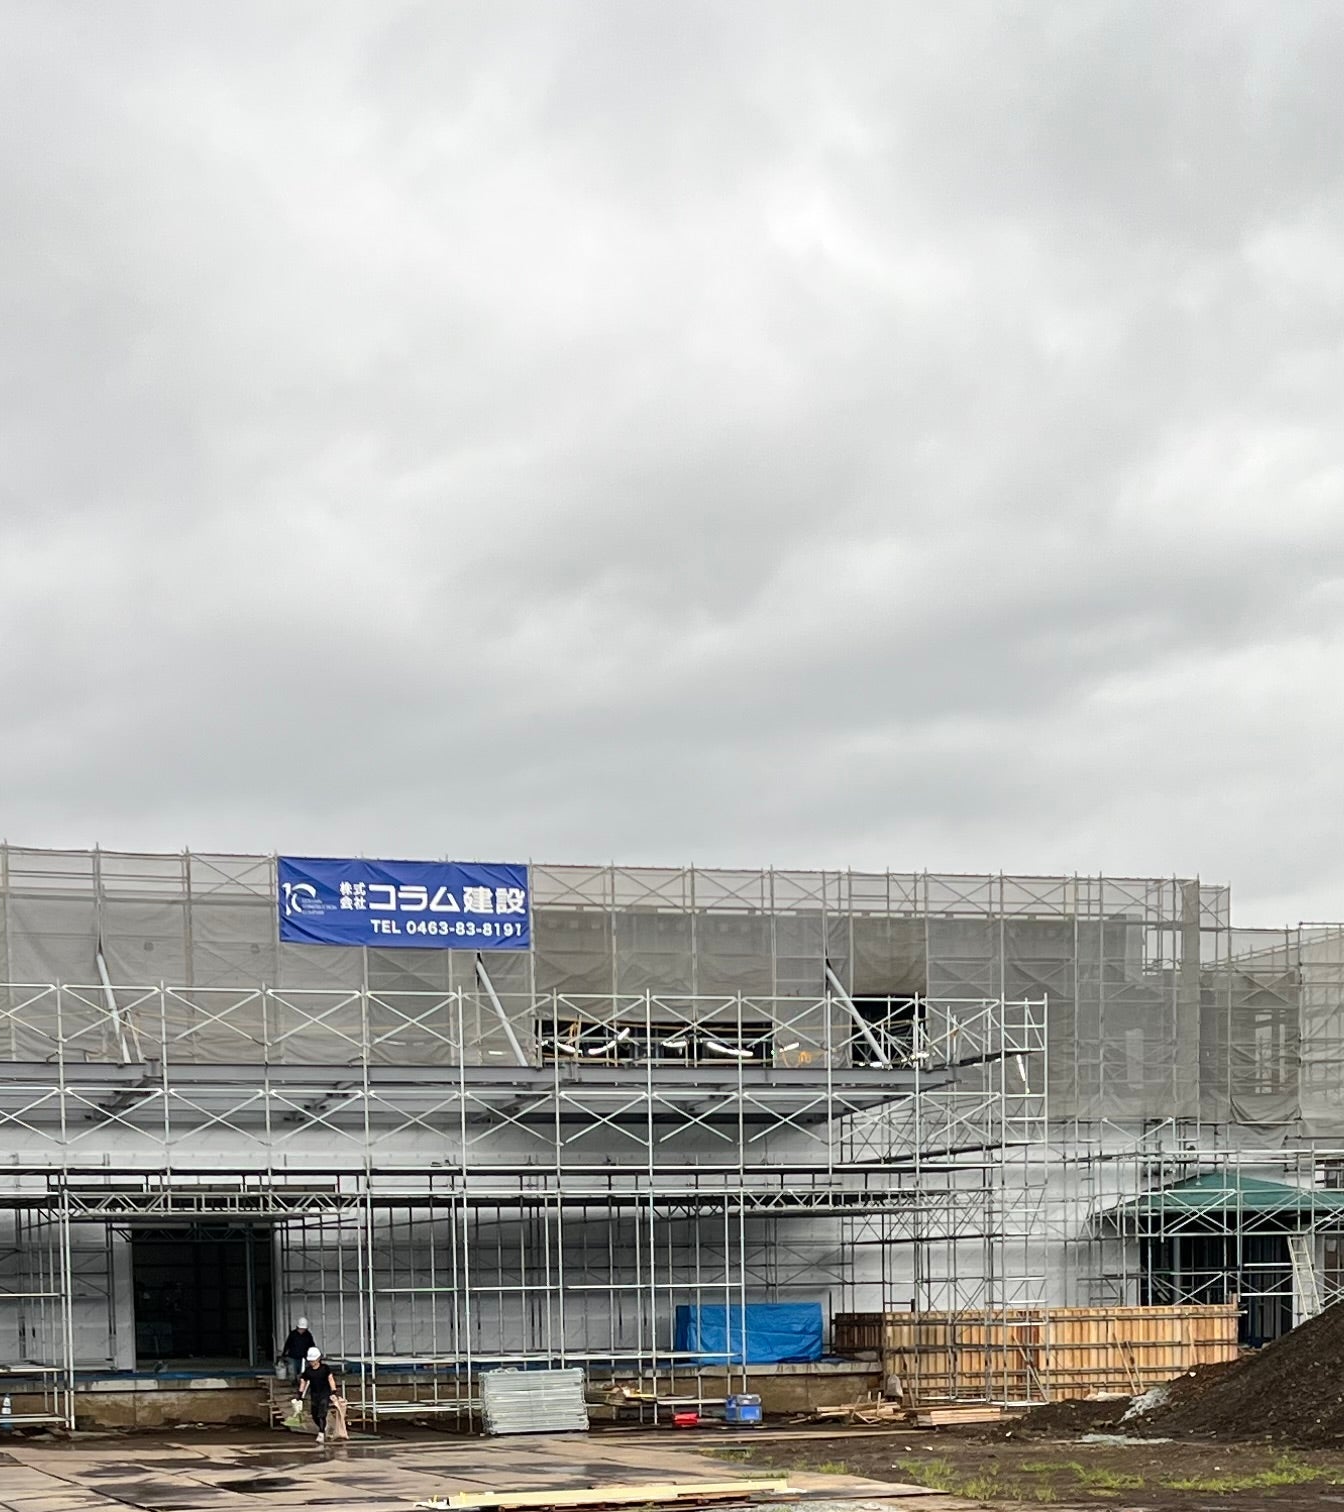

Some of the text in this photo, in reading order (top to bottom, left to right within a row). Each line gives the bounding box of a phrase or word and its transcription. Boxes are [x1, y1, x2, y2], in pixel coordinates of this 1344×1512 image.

[368, 884, 526, 914] コラム建設
[370, 919, 523, 937] TEL 0463-83-8191
